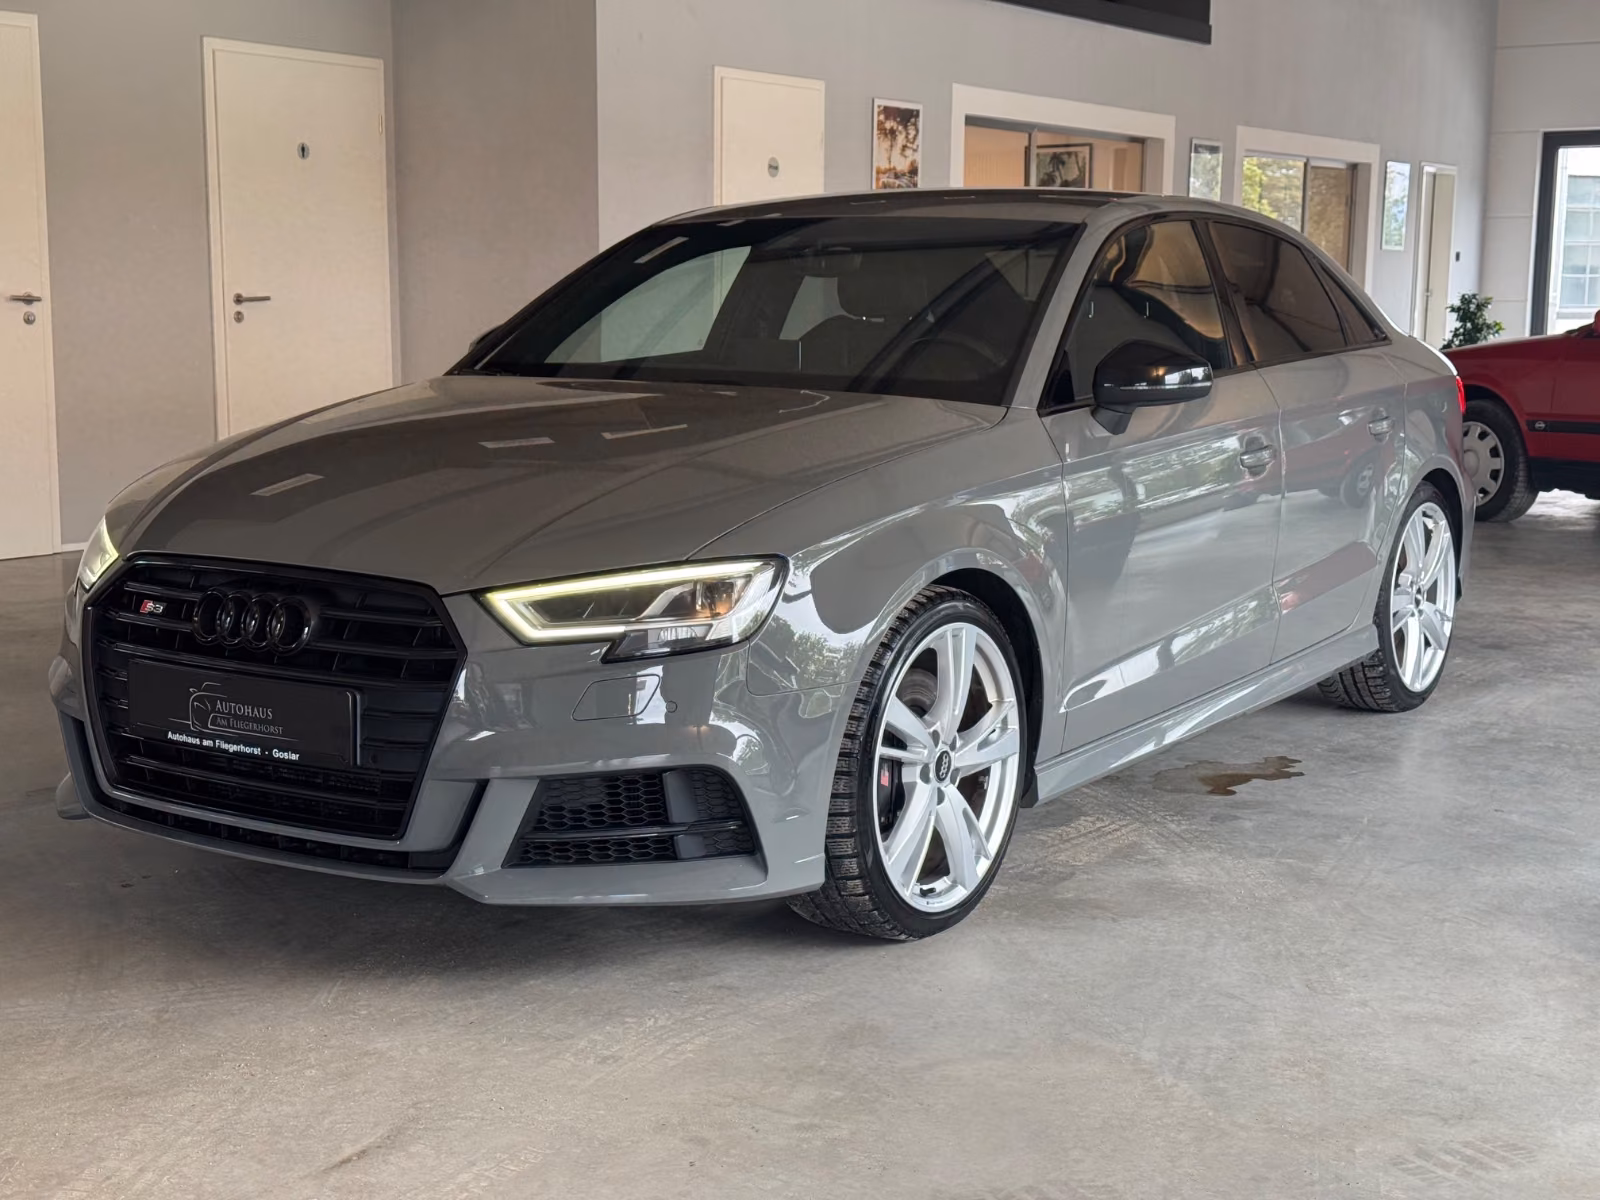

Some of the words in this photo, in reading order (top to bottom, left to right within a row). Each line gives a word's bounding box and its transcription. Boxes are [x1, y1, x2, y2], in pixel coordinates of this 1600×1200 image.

[144, 601, 163, 613] S3
[216, 700, 273, 720] AUTOHAUS
[229, 718, 283, 735] FLIEGERHORST
[167, 731, 201, 745] Autohaus
[202, 738, 214, 747] am
[215, 739, 261, 755] Fliegerhorst
[272, 748, 300, 761] Goslar
